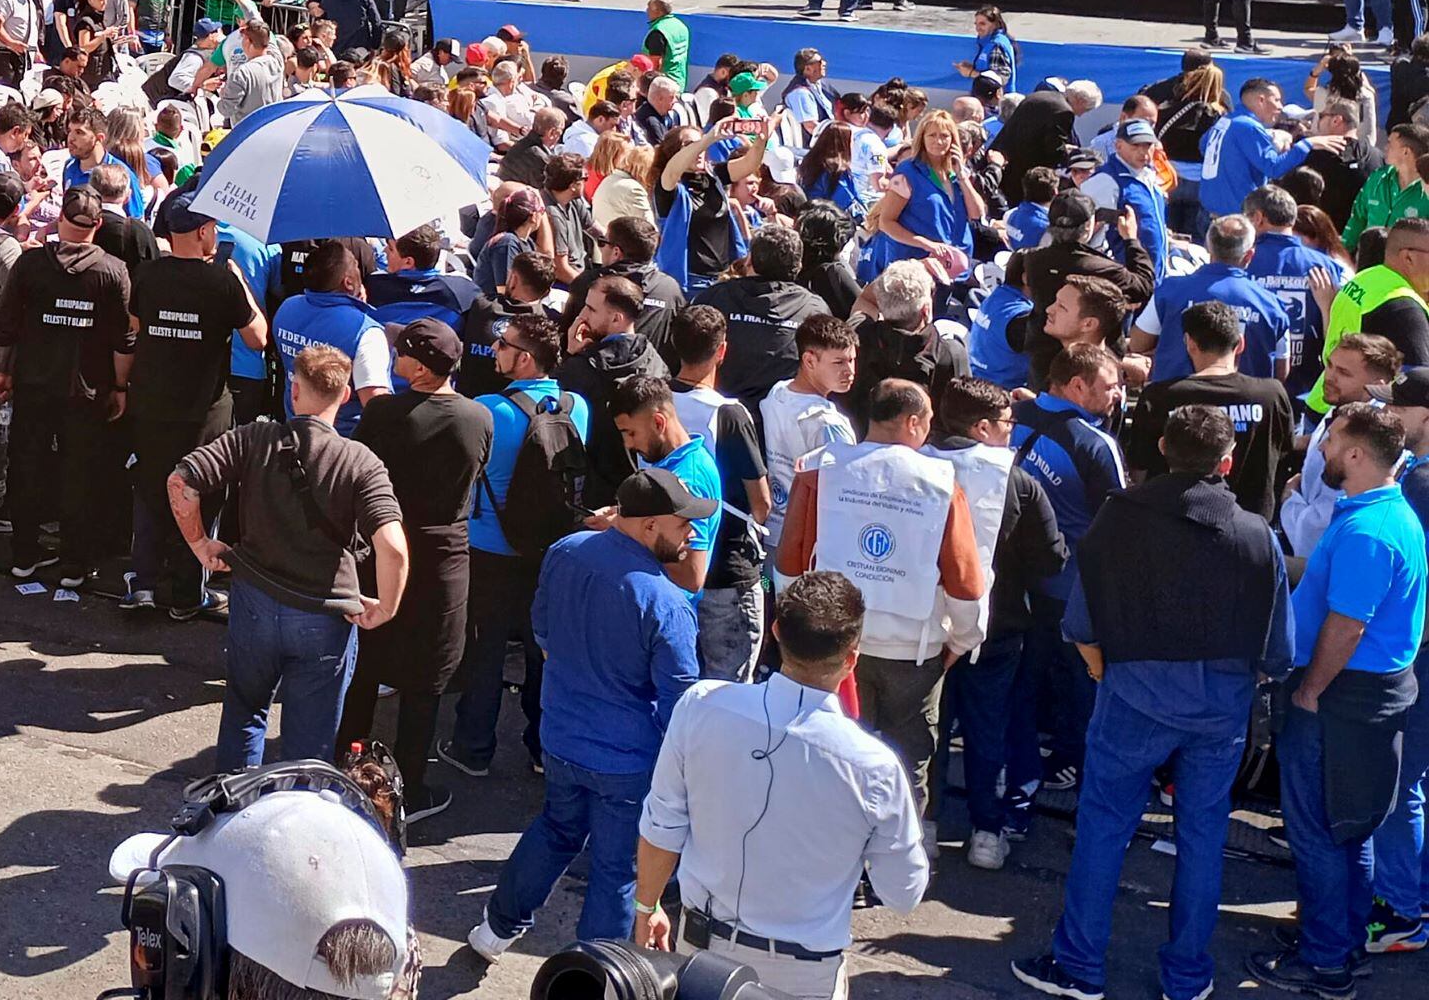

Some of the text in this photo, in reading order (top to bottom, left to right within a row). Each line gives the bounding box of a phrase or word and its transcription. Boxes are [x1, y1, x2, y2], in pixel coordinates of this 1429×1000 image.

[213, 190, 257, 220] CAPITAL
[224, 181, 258, 206] FILIAL
[135, 926, 162, 949] Telex
